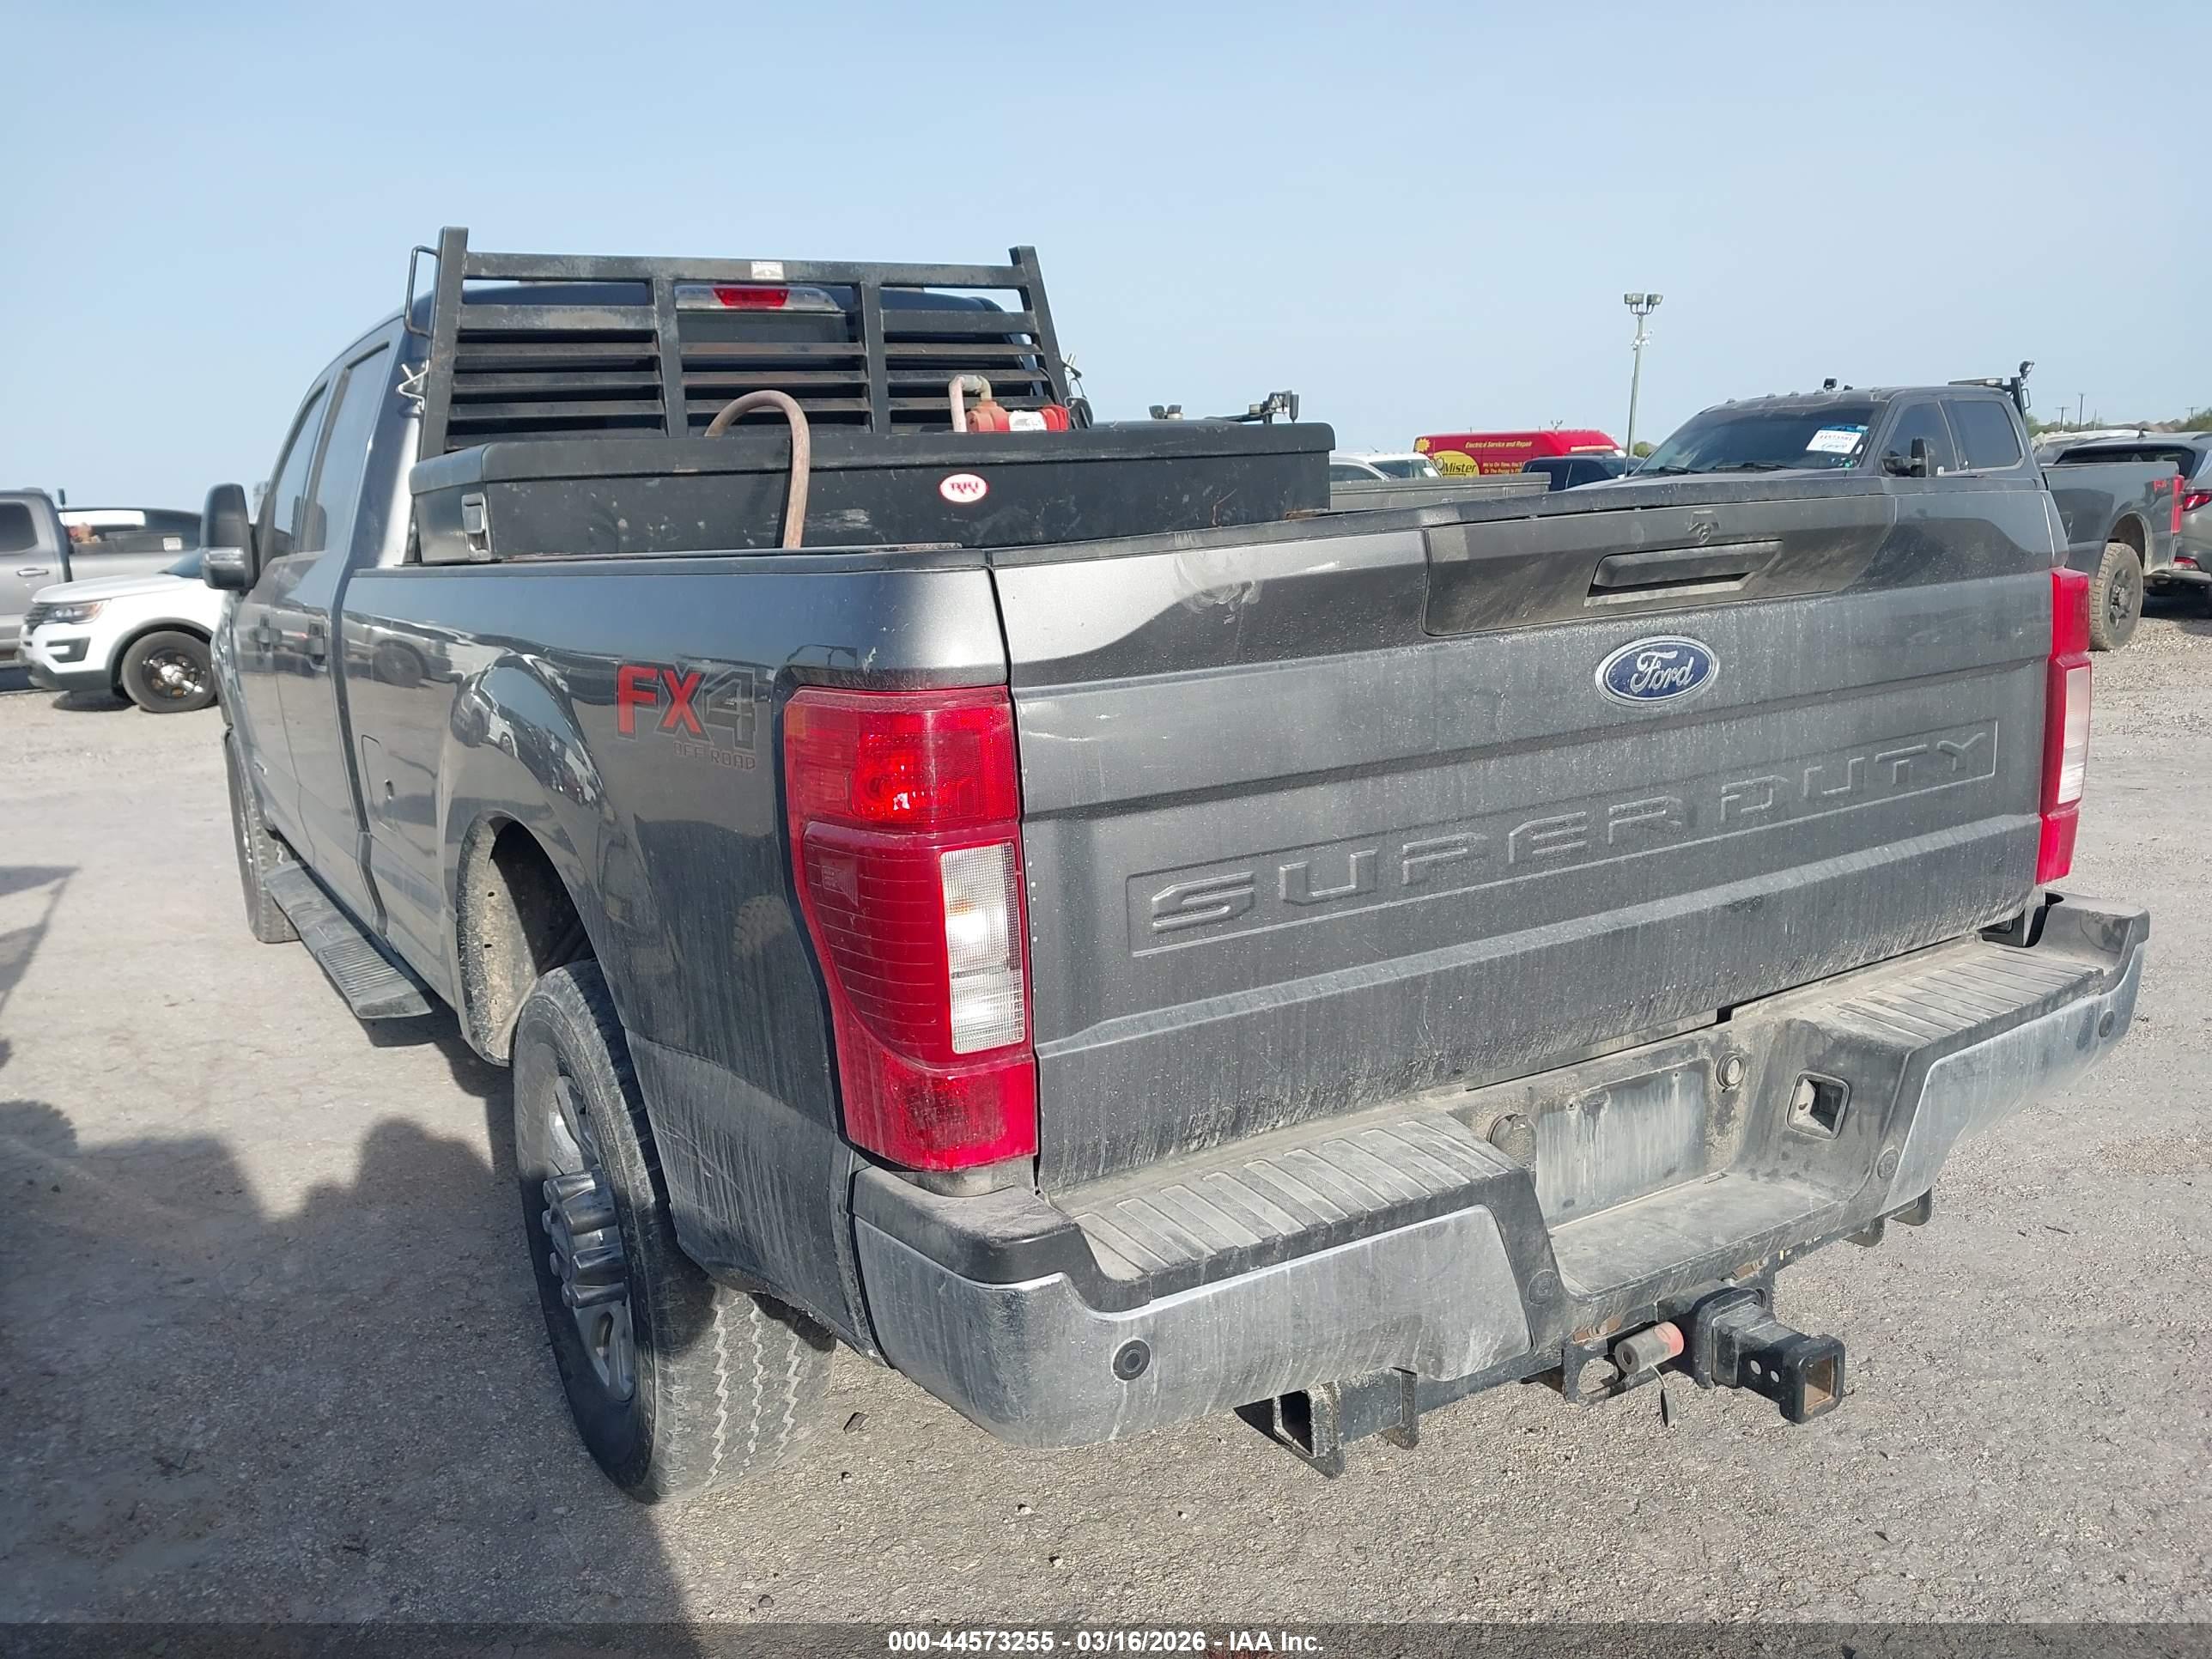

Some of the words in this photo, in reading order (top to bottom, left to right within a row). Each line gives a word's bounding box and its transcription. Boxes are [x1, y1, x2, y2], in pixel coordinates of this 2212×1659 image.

[1516, 440, 1533, 448] Repair
[1443, 463, 1477, 473] Mister
[1630, 650, 1694, 694] Ford
[615, 661, 758, 753] FX4
[672, 741, 705, 758] OFF
[709, 748, 757, 771] ROAD
[1151, 795, 1685, 933] SUPER
[1719, 732, 1987, 823] DUTY
